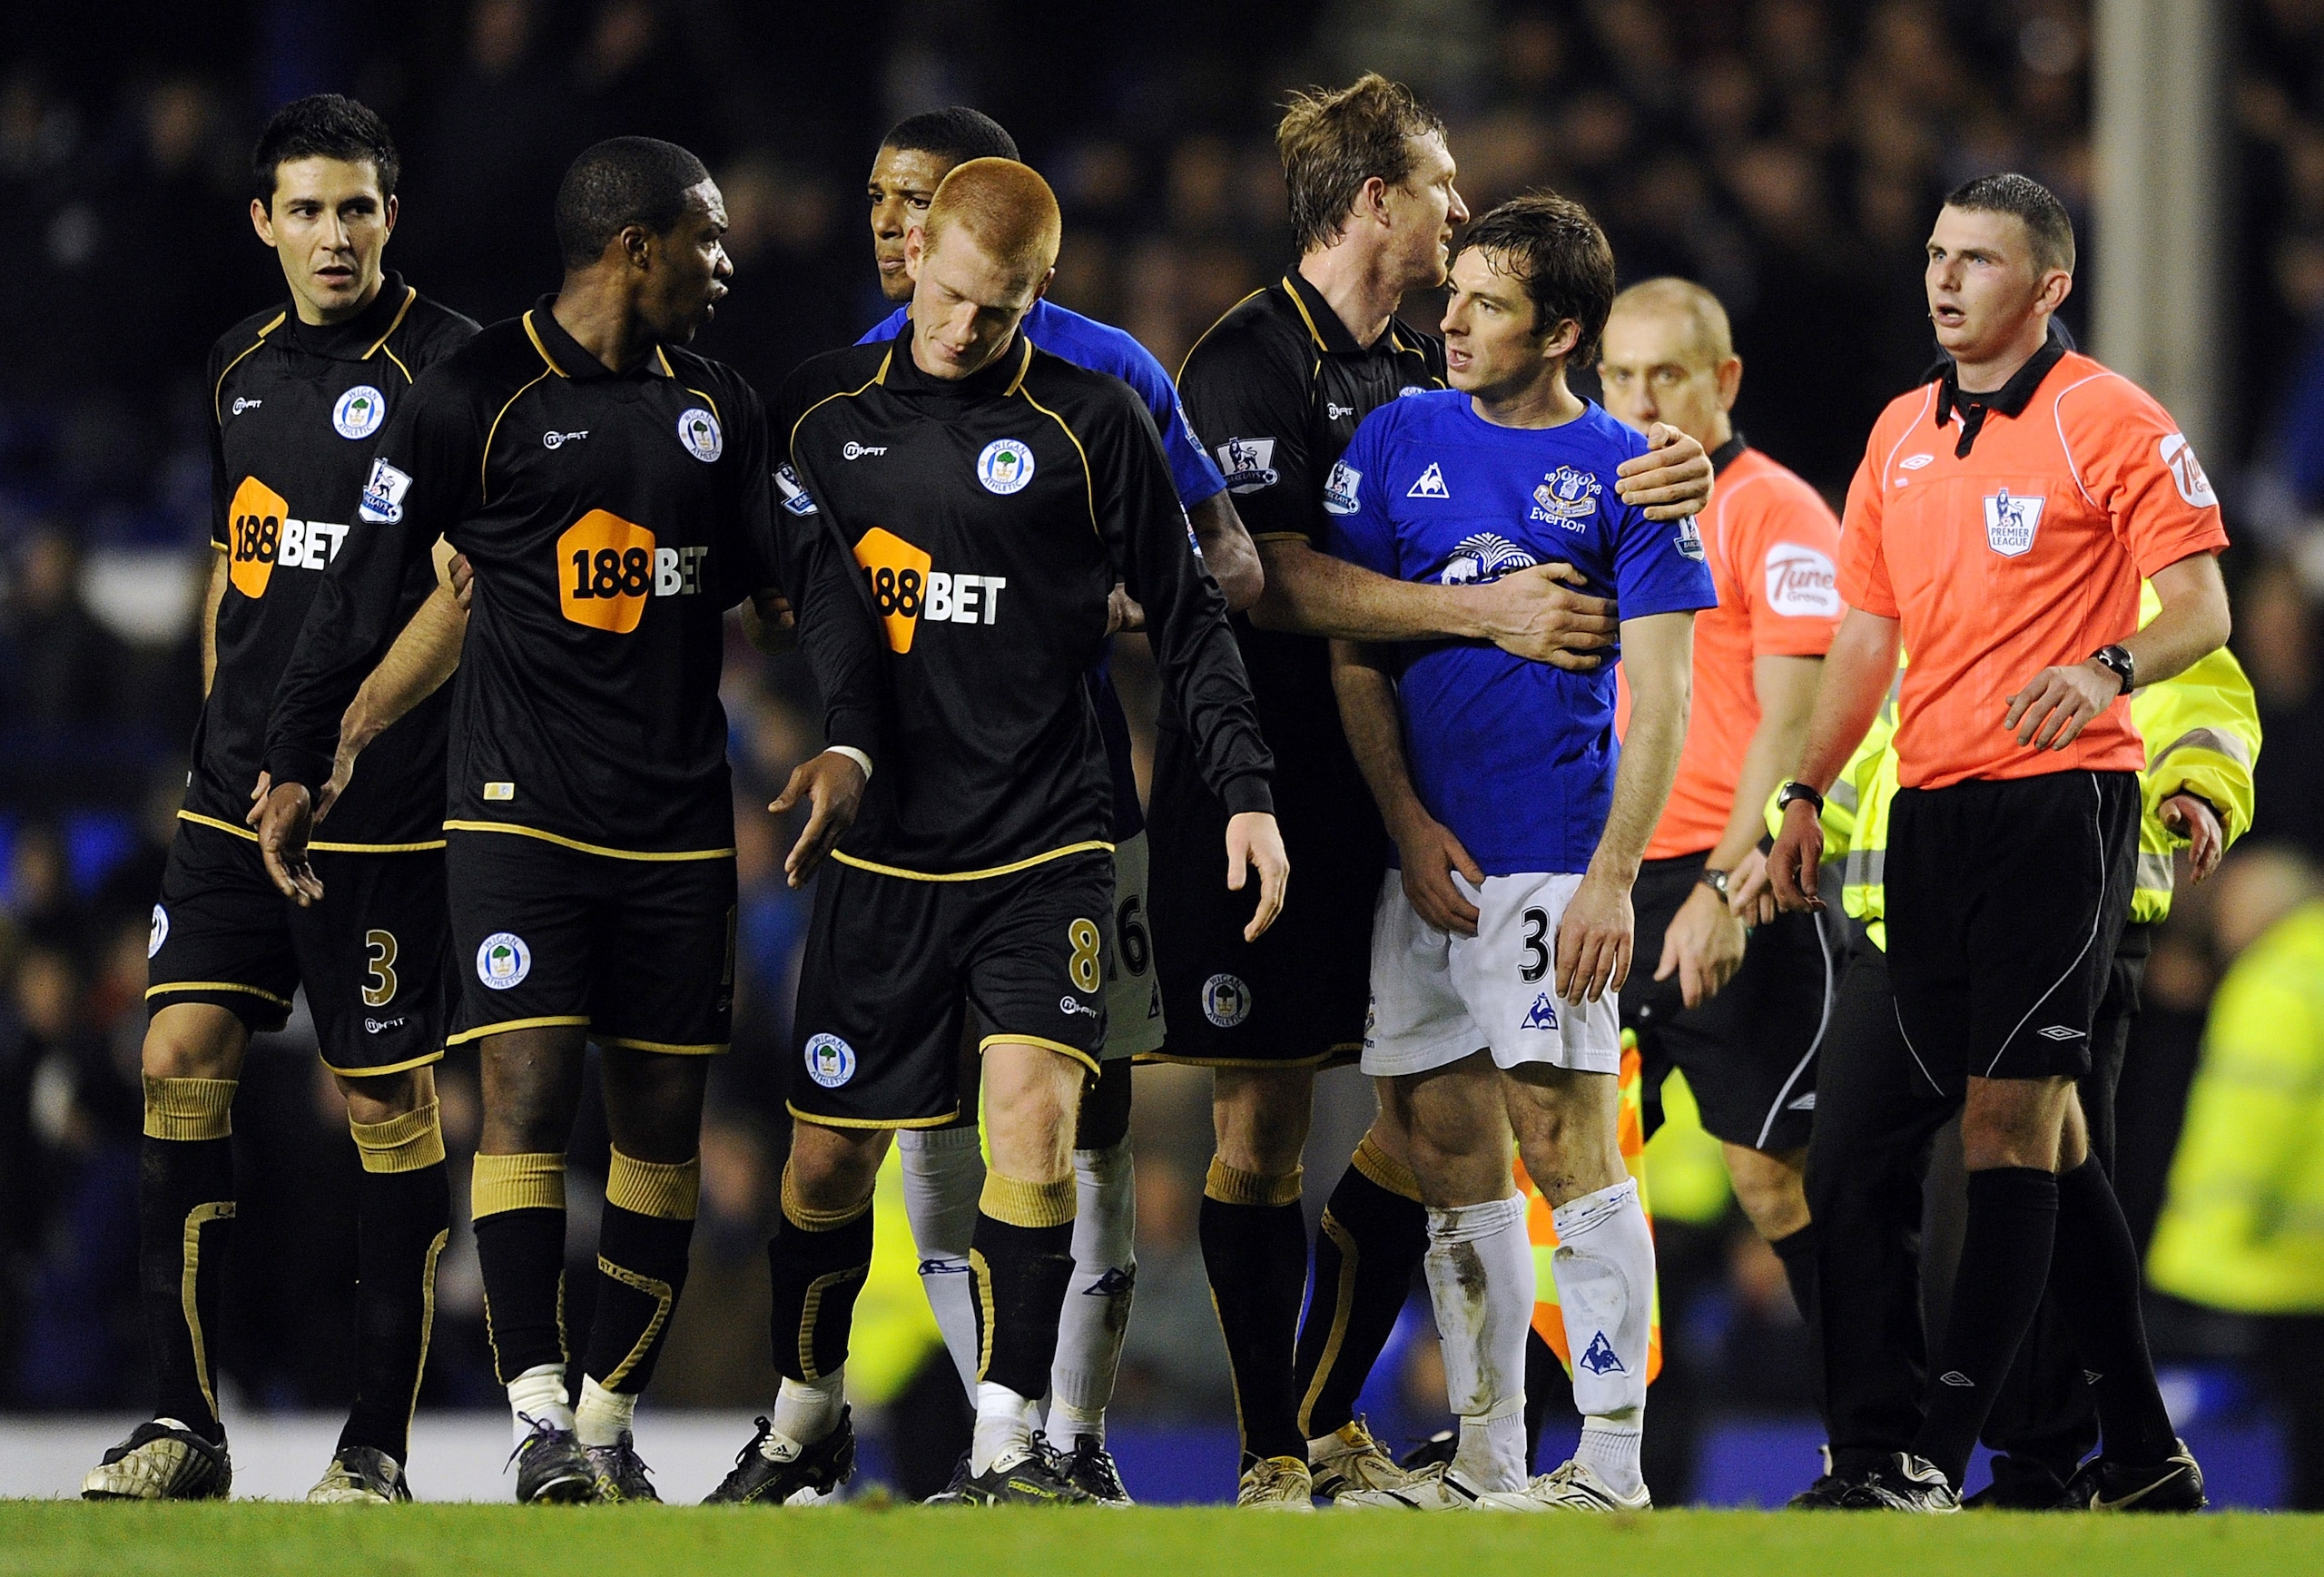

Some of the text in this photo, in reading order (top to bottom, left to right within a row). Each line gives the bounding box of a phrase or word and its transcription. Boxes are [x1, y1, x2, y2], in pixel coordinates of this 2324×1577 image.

[348, 388, 379, 400] WIGAN
[684, 409, 712, 422] WIGAN
[338, 422, 372, 437] ATHLETIC
[992, 441, 1028, 456] WIGAN
[982, 477, 1022, 492] ATHLETIC
[1544, 473, 1556, 482] 18
[1589, 484, 1602, 495] 78
[1530, 507, 1586, 534] Everton
[1991, 527, 2030, 537] PREMIER
[235, 515, 350, 571] 188BET
[1993, 537, 2028, 547] LEAGUE
[572, 547, 709, 599] 188BET
[483, 934, 520, 948] WIGAN
[1517, 905, 1551, 985] 3
[1068, 918, 1101, 994] 8
[361, 929, 399, 1008] 3
[483, 971, 525, 988] ATHLETIC
[812, 1035, 845, 1050] WIGAN
[811, 1070, 849, 1086] ATHLETIC
